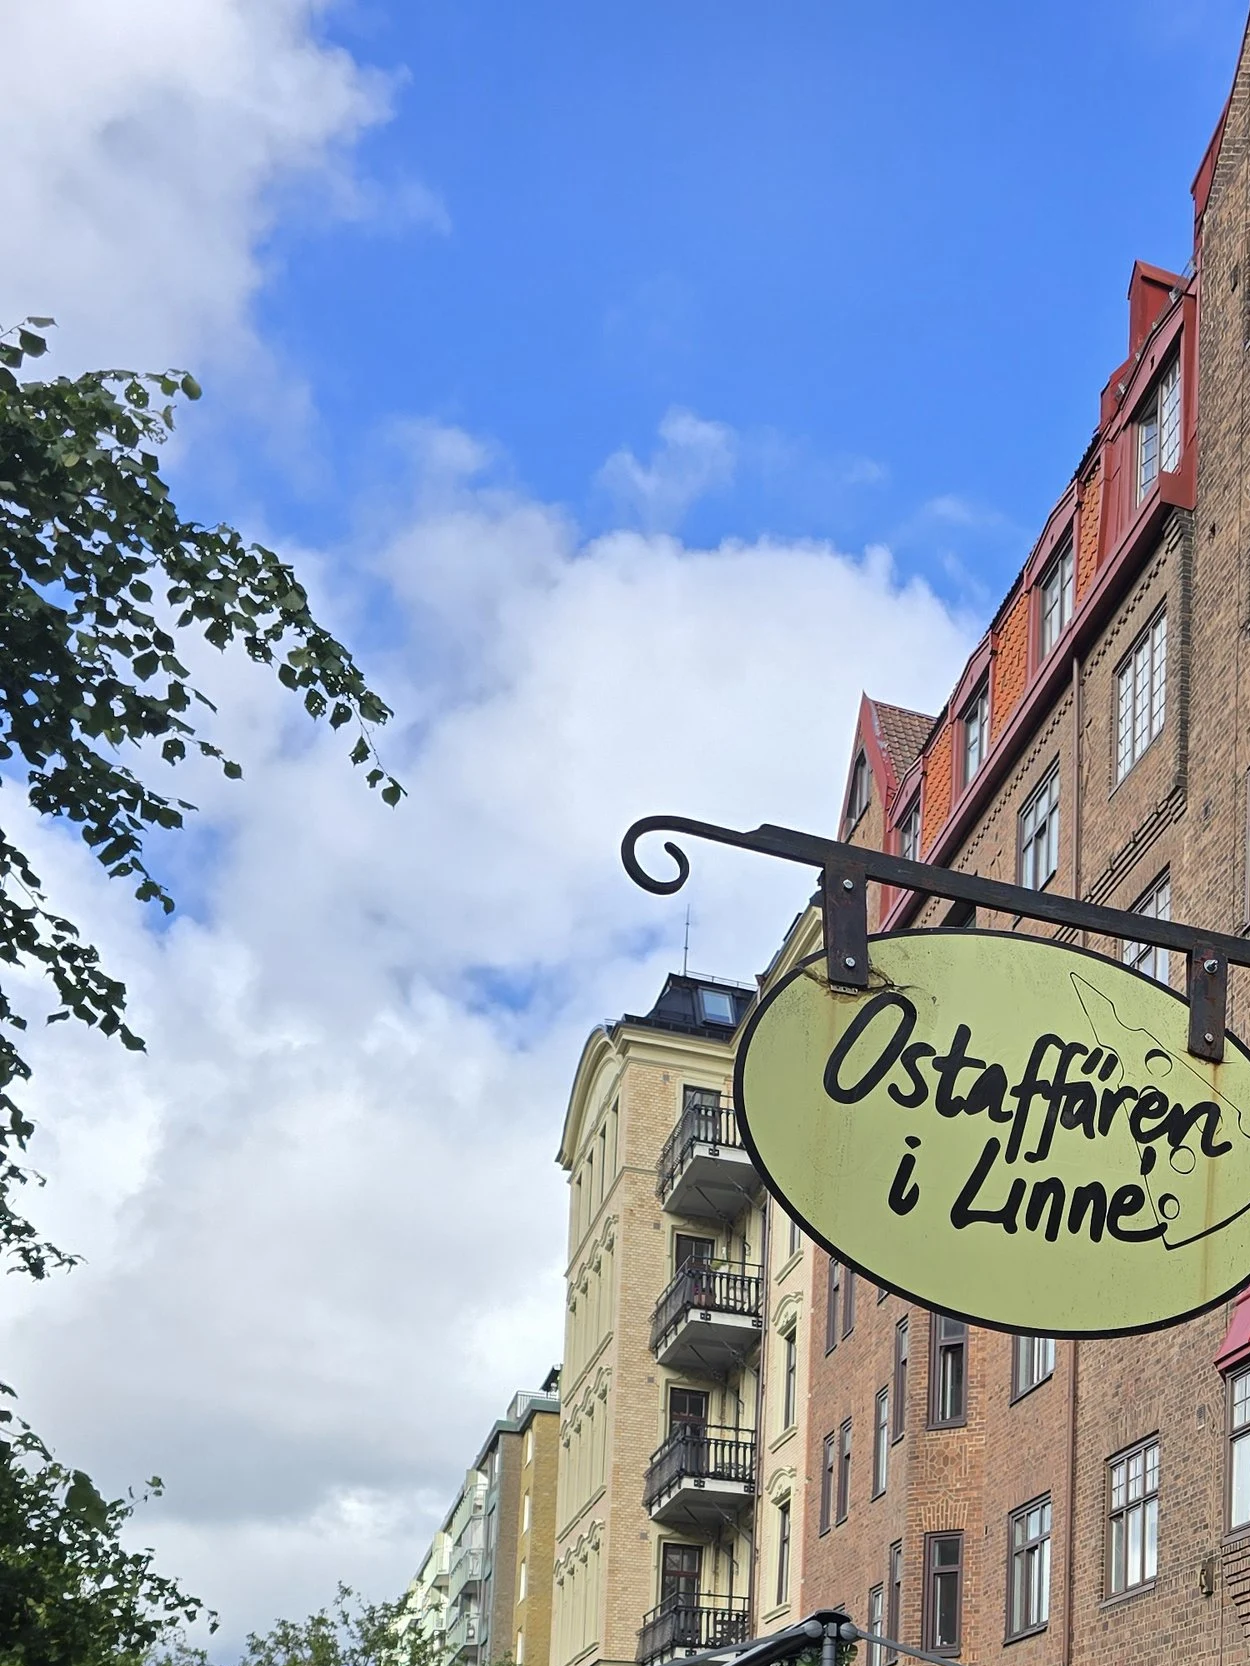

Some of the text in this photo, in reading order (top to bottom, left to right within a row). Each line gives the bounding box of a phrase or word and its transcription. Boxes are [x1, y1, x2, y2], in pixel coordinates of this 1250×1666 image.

[822, 991, 1233, 1165] Ostaffären
[887, 1136, 1168, 1243] i Linné
